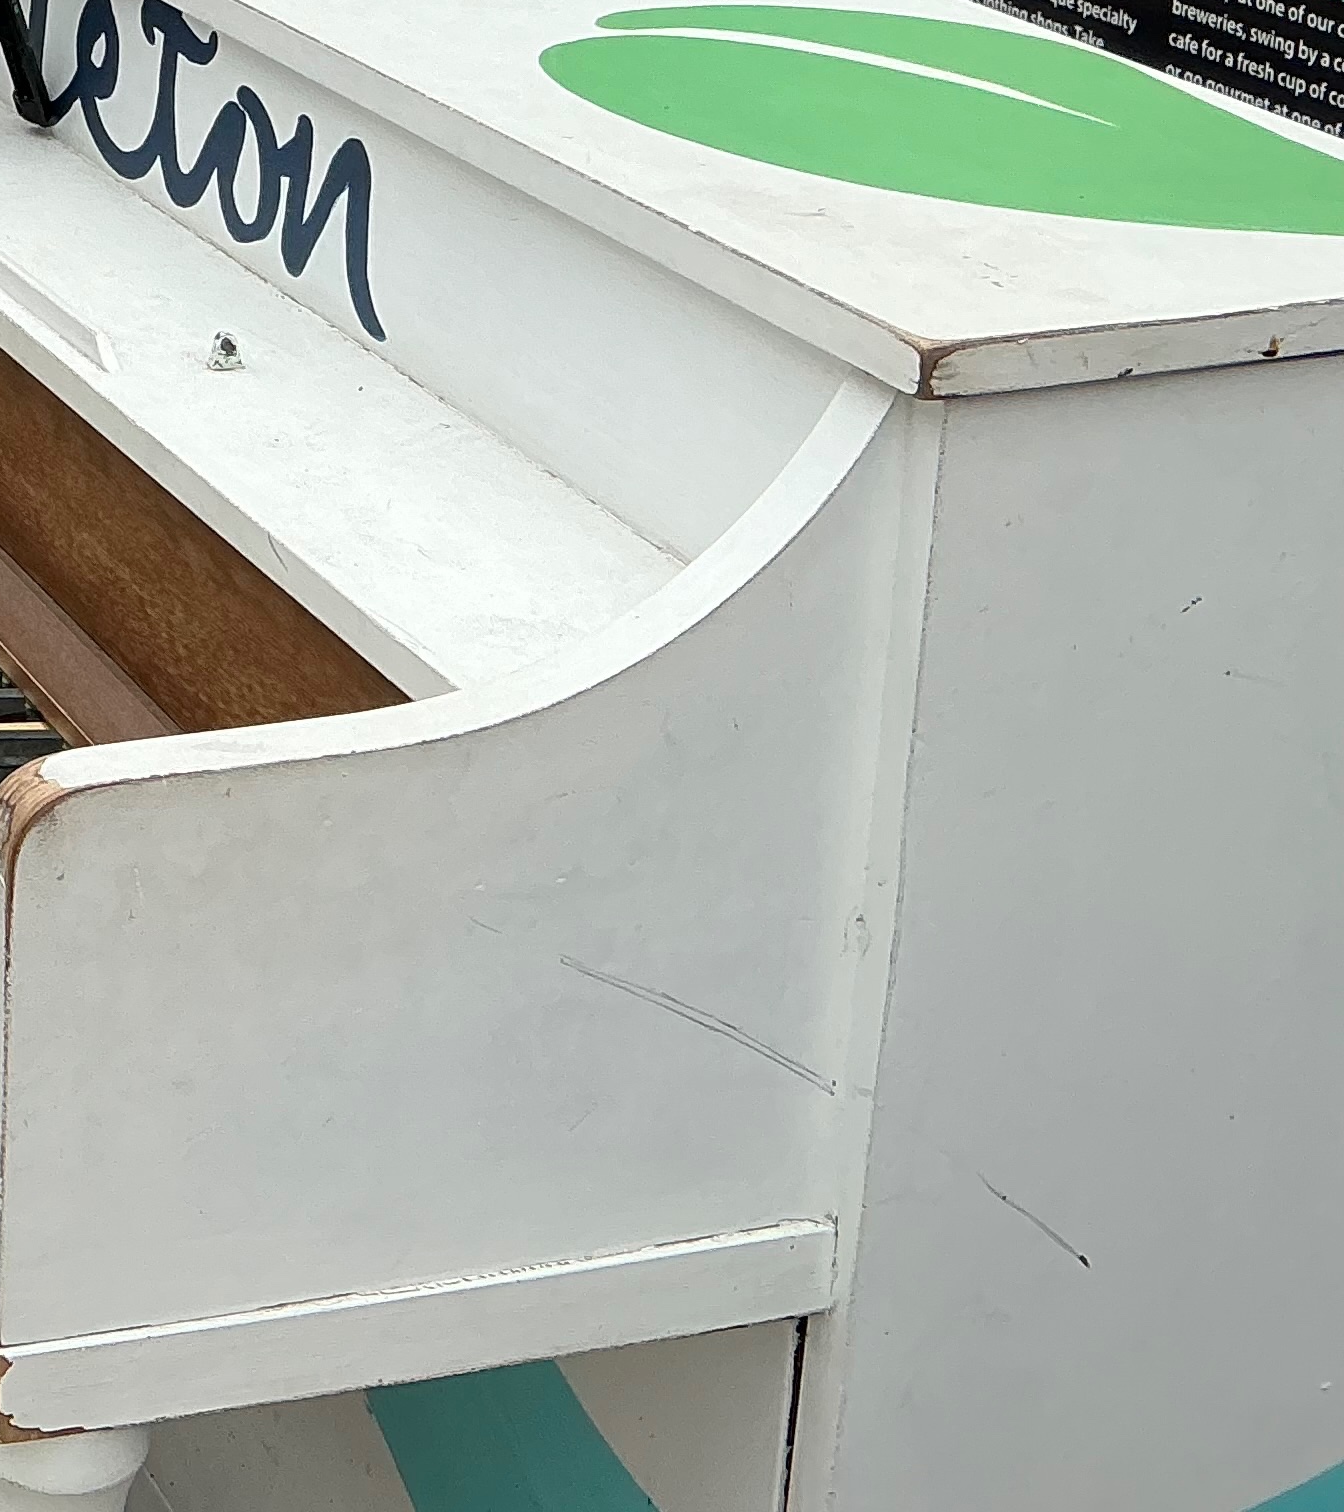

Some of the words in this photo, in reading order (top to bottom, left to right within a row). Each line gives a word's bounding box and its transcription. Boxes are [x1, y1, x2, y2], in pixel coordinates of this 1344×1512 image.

[1074, 24, 1105, 48] Take
[1287, 4, 1306, 24] of
[1306, 12, 1335, 34] our
[1168, 31, 1199, 55] cafe
[1201, 39, 1224, 63] for
[1224, 51, 1234, 68] a
[1235, 52, 1274, 83] fresh
[1277, 71, 1307, 97] cup
[1309, 81, 1328, 101] of
[1249, 27, 1294, 60] swing
[1298, 38, 1318, 67] by
[1320, 52, 1330, 68] a
[1165, 63, 1182, 78] or
[1273, 103, 1289, 119] at
[1291, 111, 1320, 130] one
[1323, 121, 1343, 137] of
